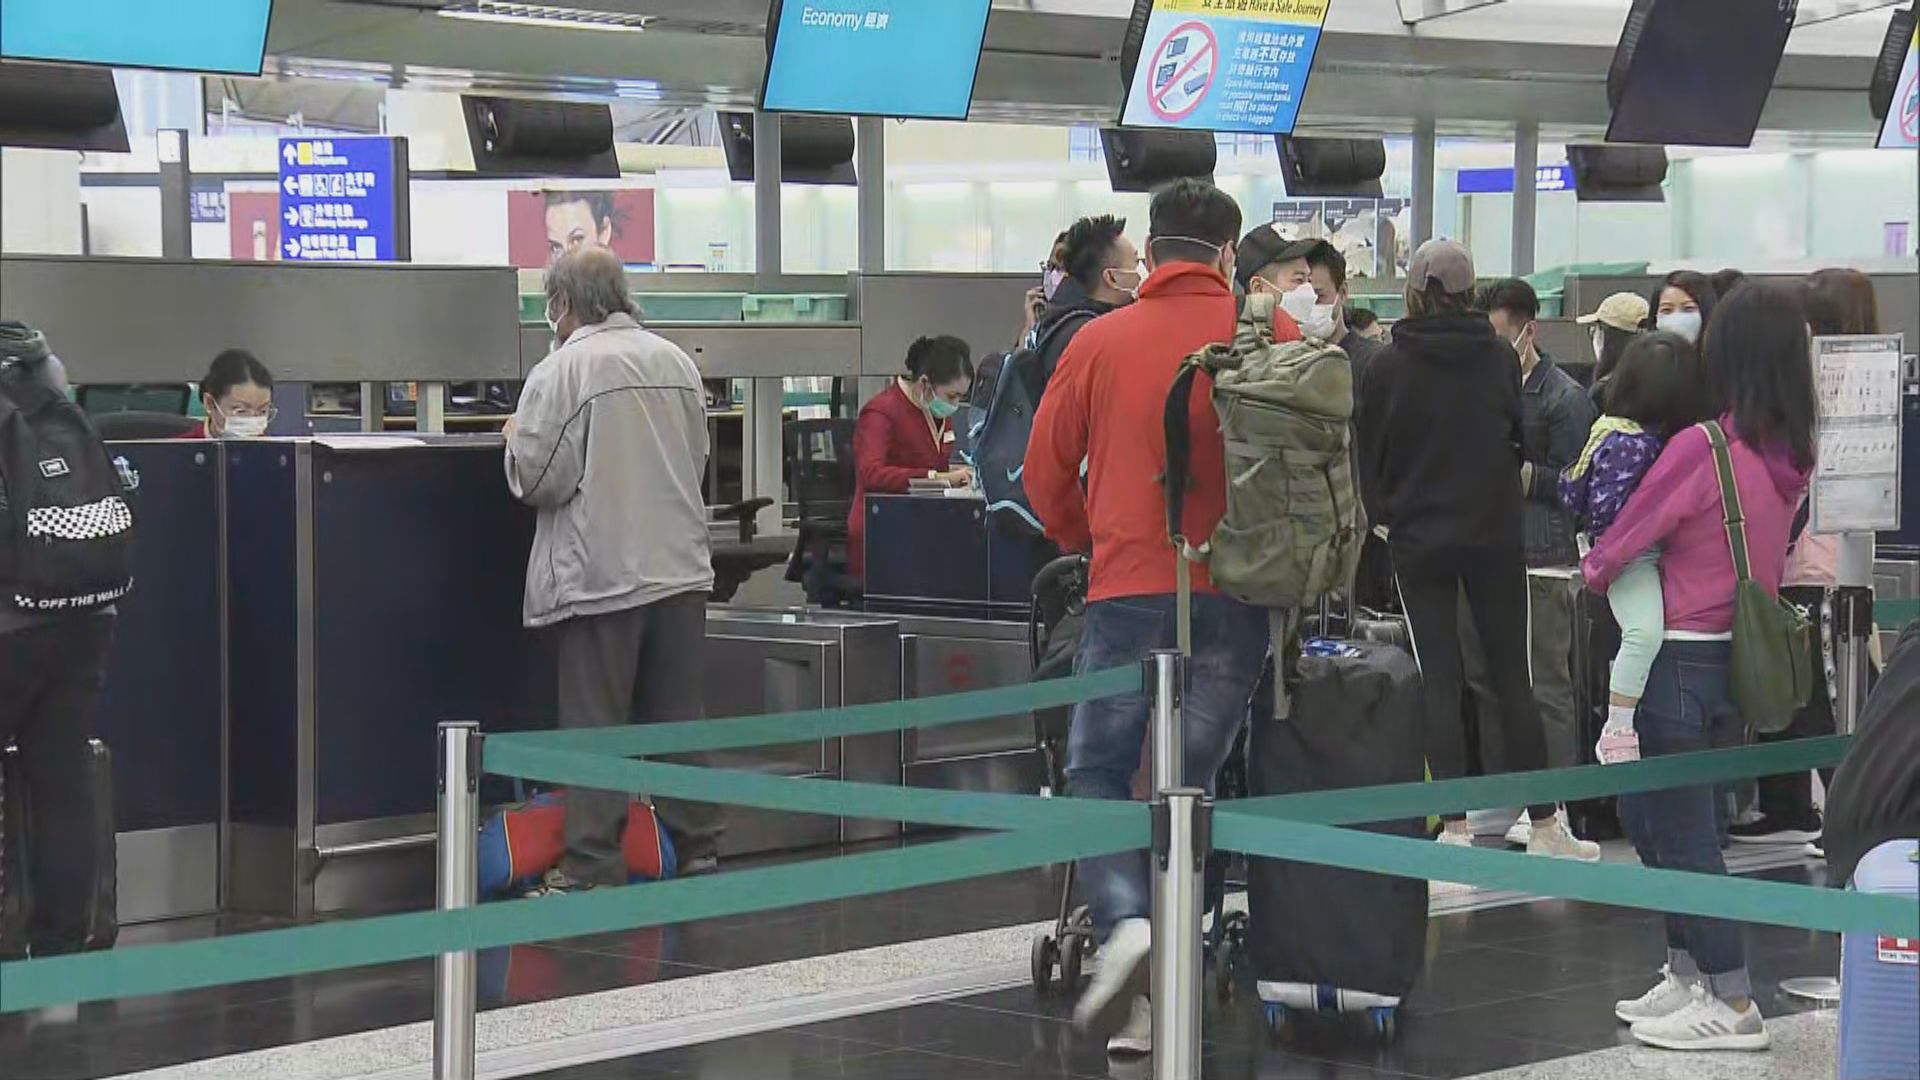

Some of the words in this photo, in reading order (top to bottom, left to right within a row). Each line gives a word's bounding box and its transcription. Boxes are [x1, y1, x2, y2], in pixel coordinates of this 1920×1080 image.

[802, 7, 862, 31] Economy
[1275, 1, 1291, 14] Safe
[1293, 3, 1325, 19] Journey
[1233, 100, 1250, 113] NOT
[38, 597, 69, 610] OFF
[70, 593, 95, 608] THE
[96, 585, 125, 603] WALL
